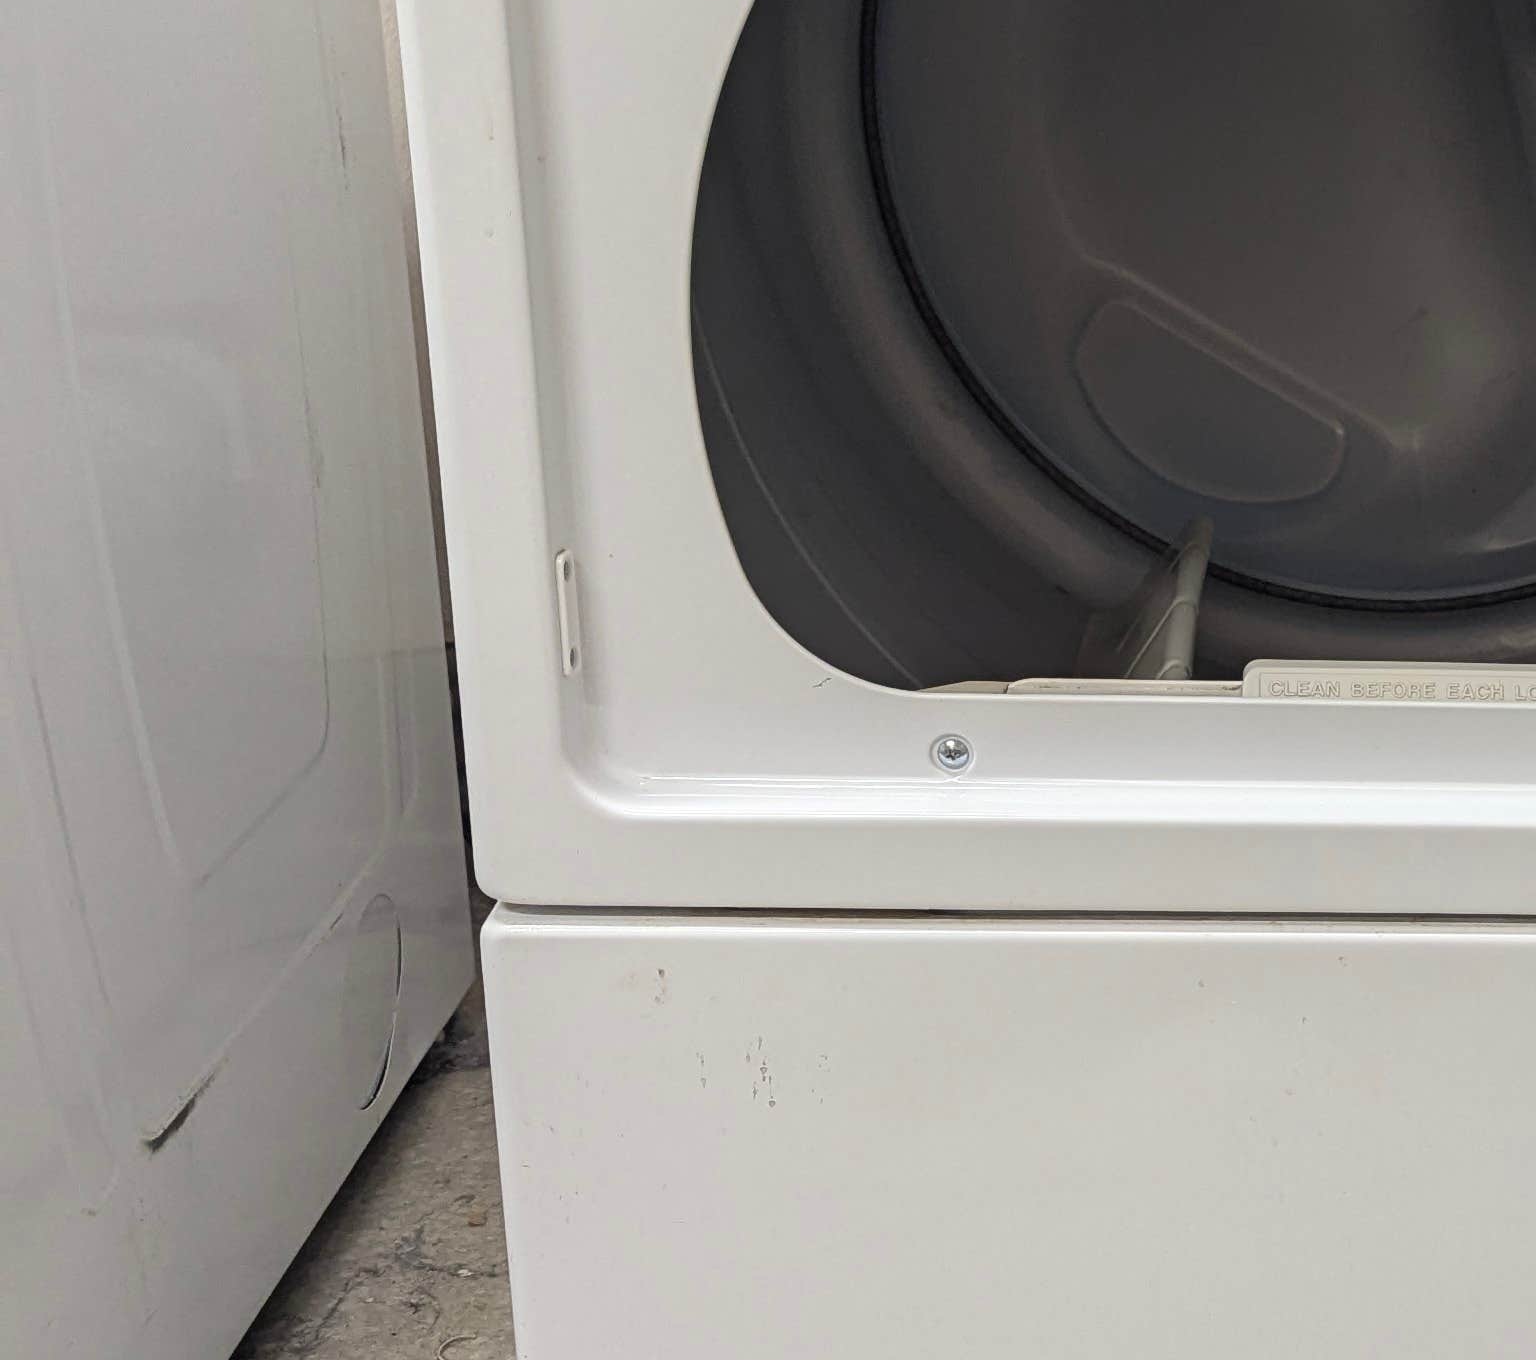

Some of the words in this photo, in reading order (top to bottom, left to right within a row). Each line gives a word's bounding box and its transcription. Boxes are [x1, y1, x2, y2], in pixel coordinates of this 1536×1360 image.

[1269, 678, 1340, 698] CLEAN
[1350, 680, 1436, 700] BEFORE
[1446, 682, 1505, 702] EACH
